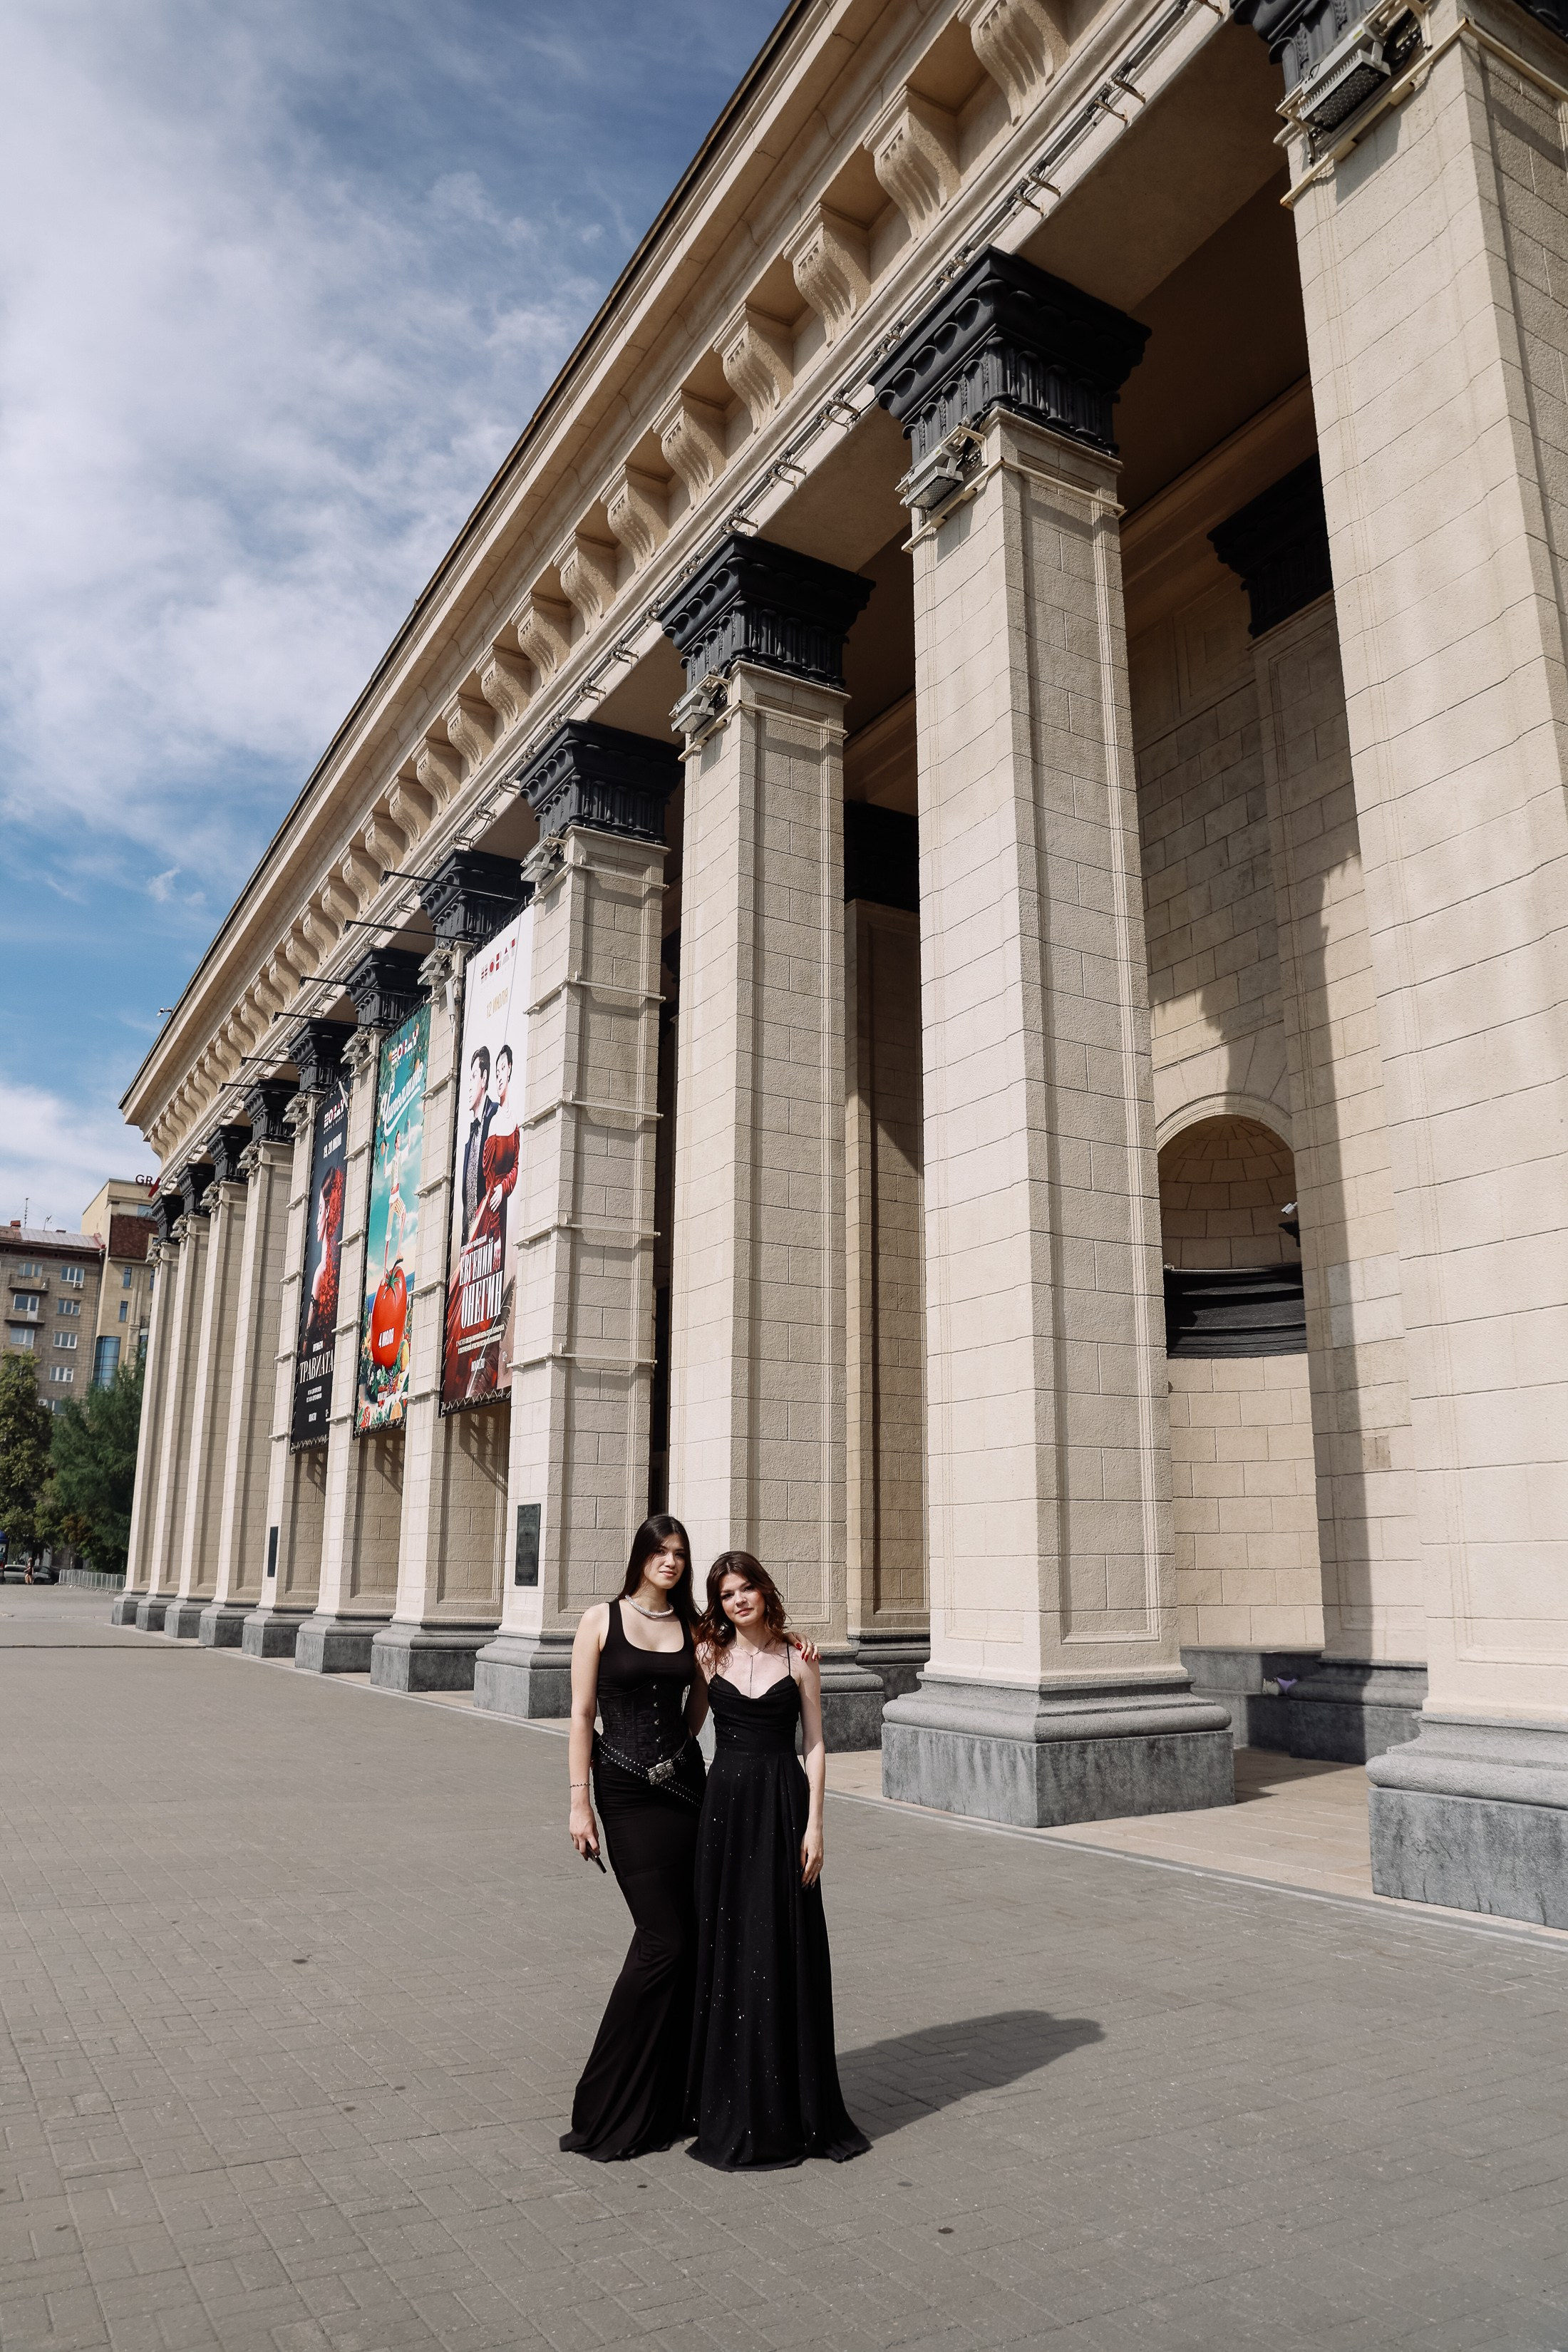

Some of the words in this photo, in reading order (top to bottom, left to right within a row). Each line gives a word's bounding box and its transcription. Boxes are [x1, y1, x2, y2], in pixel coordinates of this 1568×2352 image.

[487, 1001, 492, 1018] 12
[493, 987, 508, 1013] ИЮЛЯ
[459, 1237, 493, 1286] ЕВГЕНИЙ
[460, 1270, 503, 1329] ОНЕГИН
[378, 1332, 383, 1348] 4
[299, 1349, 334, 1384] ТРАВИАТА
